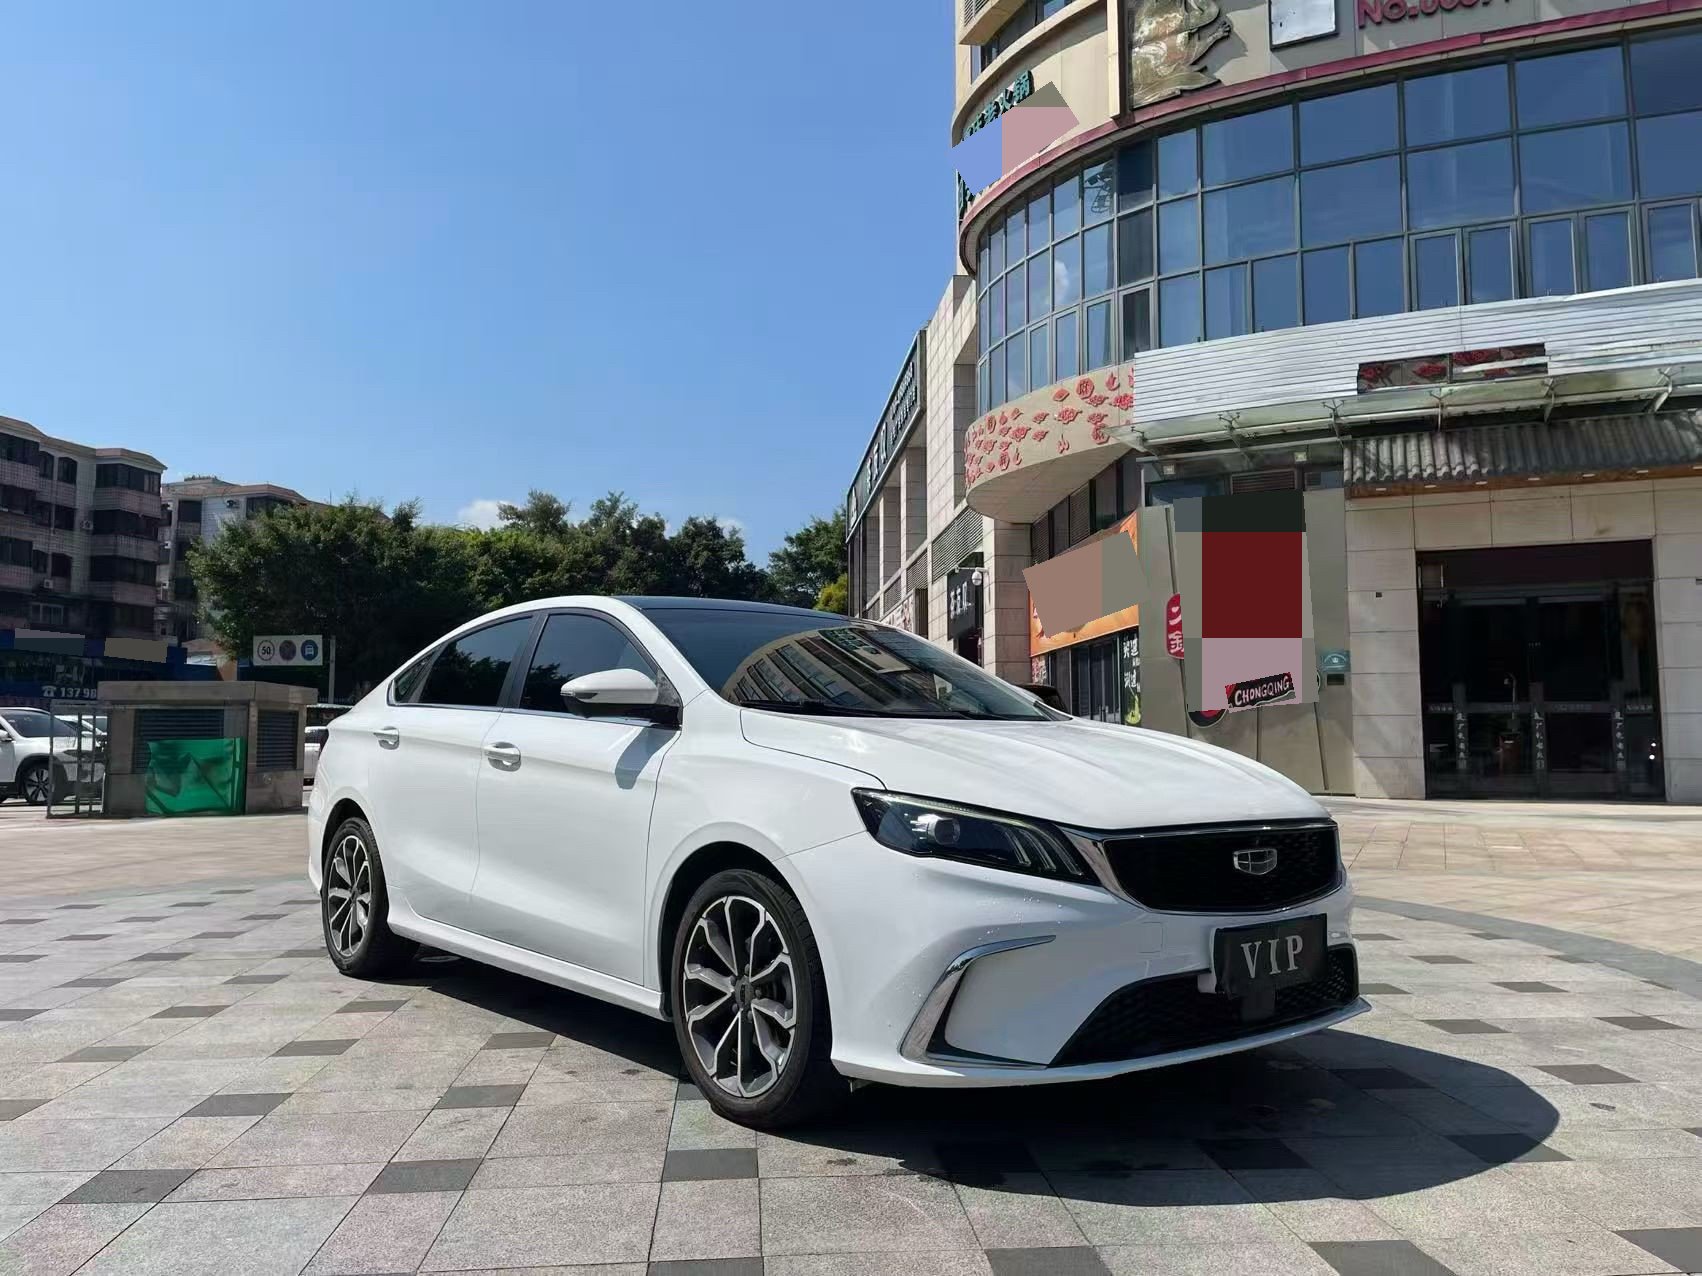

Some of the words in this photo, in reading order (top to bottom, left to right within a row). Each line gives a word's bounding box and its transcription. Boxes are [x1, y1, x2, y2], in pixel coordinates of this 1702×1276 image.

[261, 646, 271, 655] 50
[60, 687, 81, 698] 137
[1234, 675, 1290, 706] CHONGQING
[1240, 935, 1304, 979] VIP
